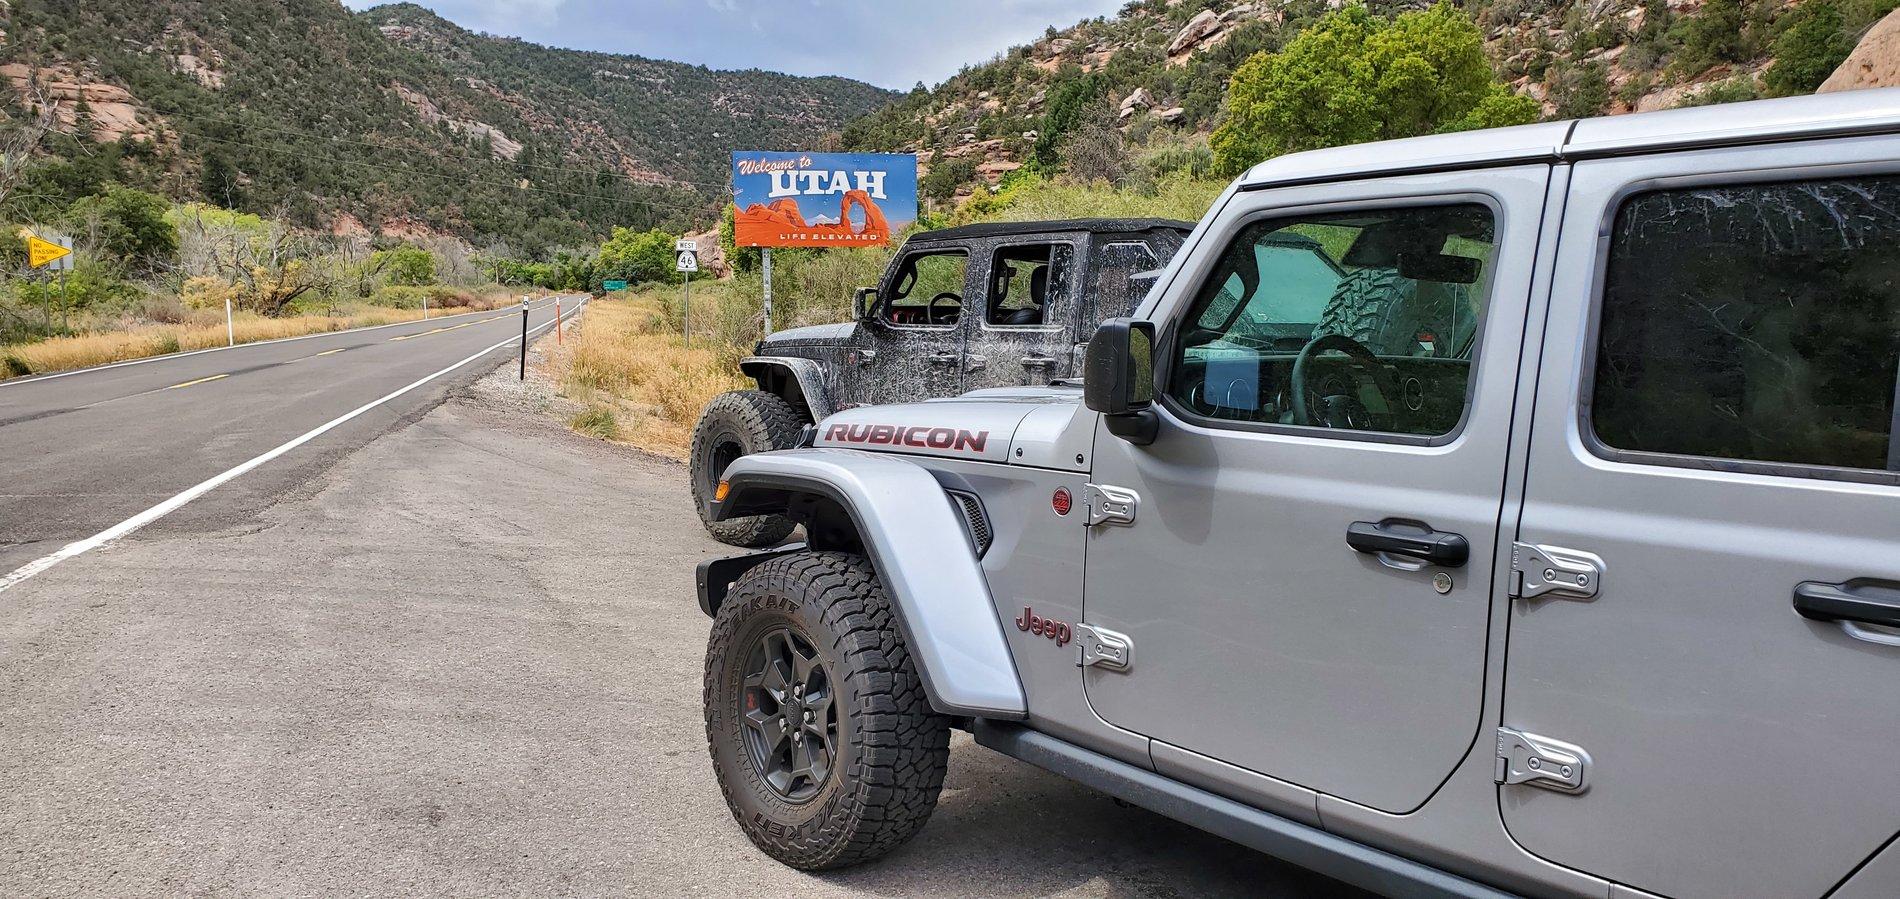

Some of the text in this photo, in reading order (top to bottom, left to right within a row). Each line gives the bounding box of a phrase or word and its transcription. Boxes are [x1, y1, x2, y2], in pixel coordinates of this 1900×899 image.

[738, 155, 813, 176] Welcome to
[768, 170, 888, 200] UTAH
[812, 233, 878, 241] ELEVATED
[680, 256, 693, 265] 46
[824, 423, 990, 453] RUBICON
[1015, 605, 1072, 648] Jeep
